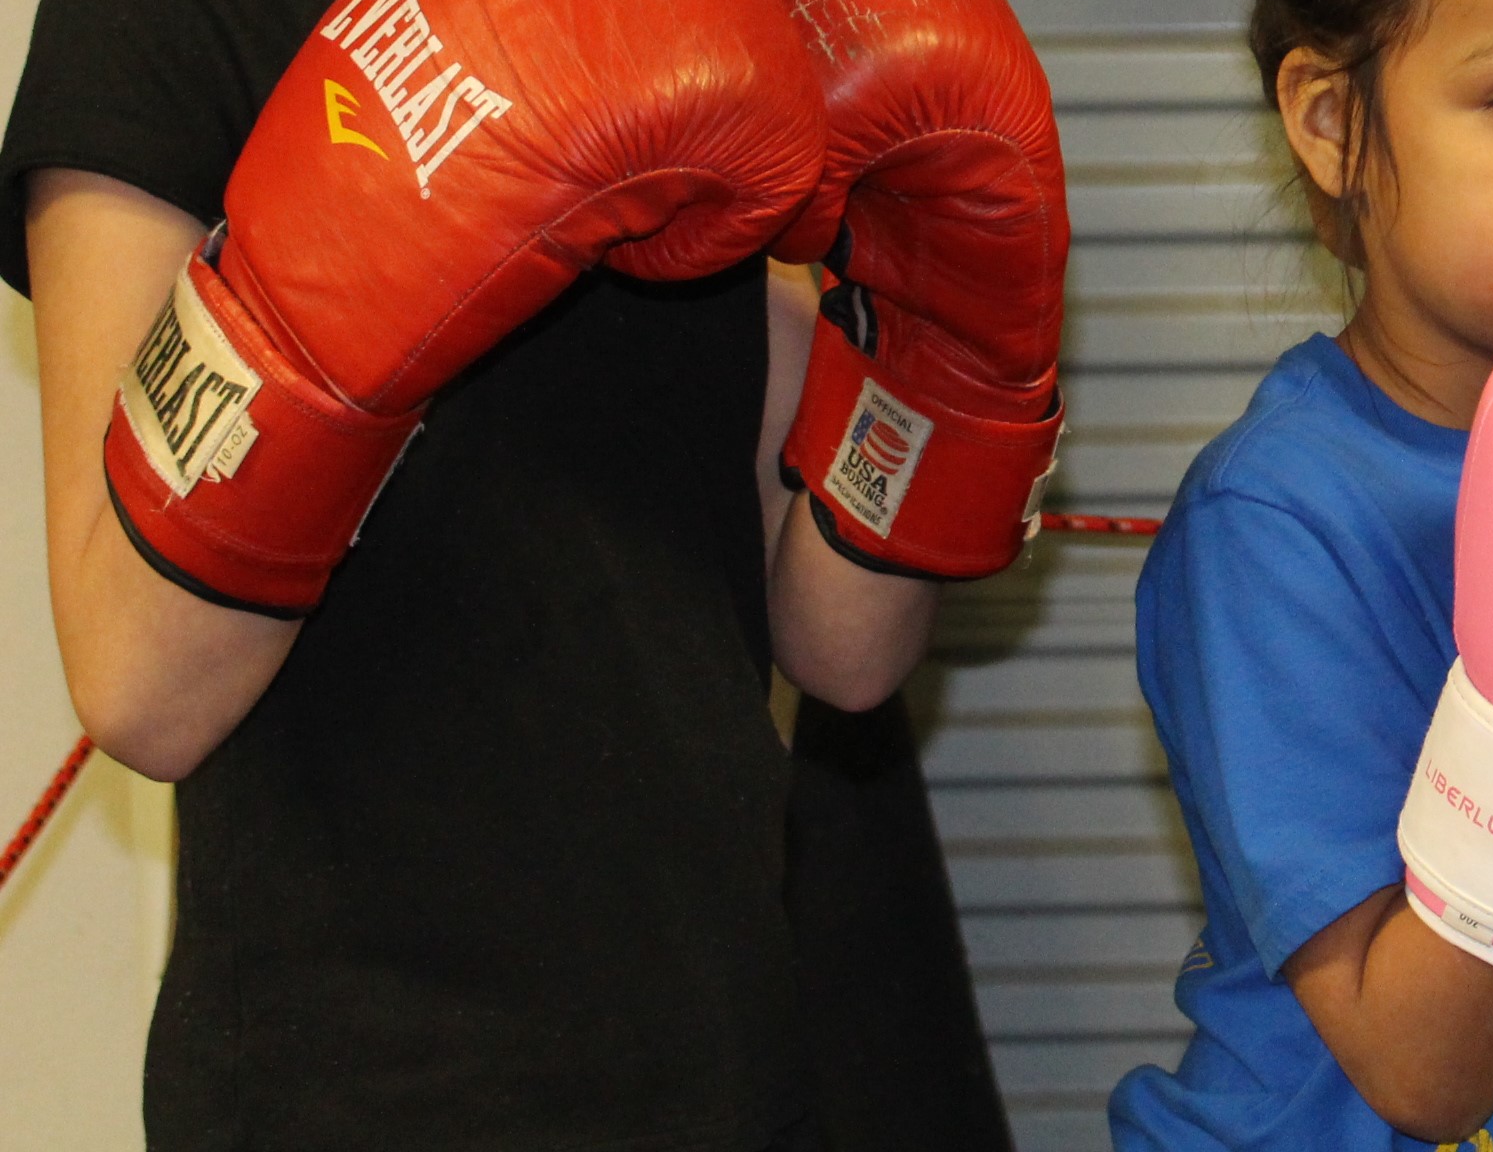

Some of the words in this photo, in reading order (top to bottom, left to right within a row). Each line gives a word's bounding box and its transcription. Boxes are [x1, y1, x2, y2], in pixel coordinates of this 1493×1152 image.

[134, 286, 249, 478] ERLAST
[871, 393, 914, 434] OFFICIAL
[839, 462, 886, 511] BOXING
[847, 447, 888, 497] USA
